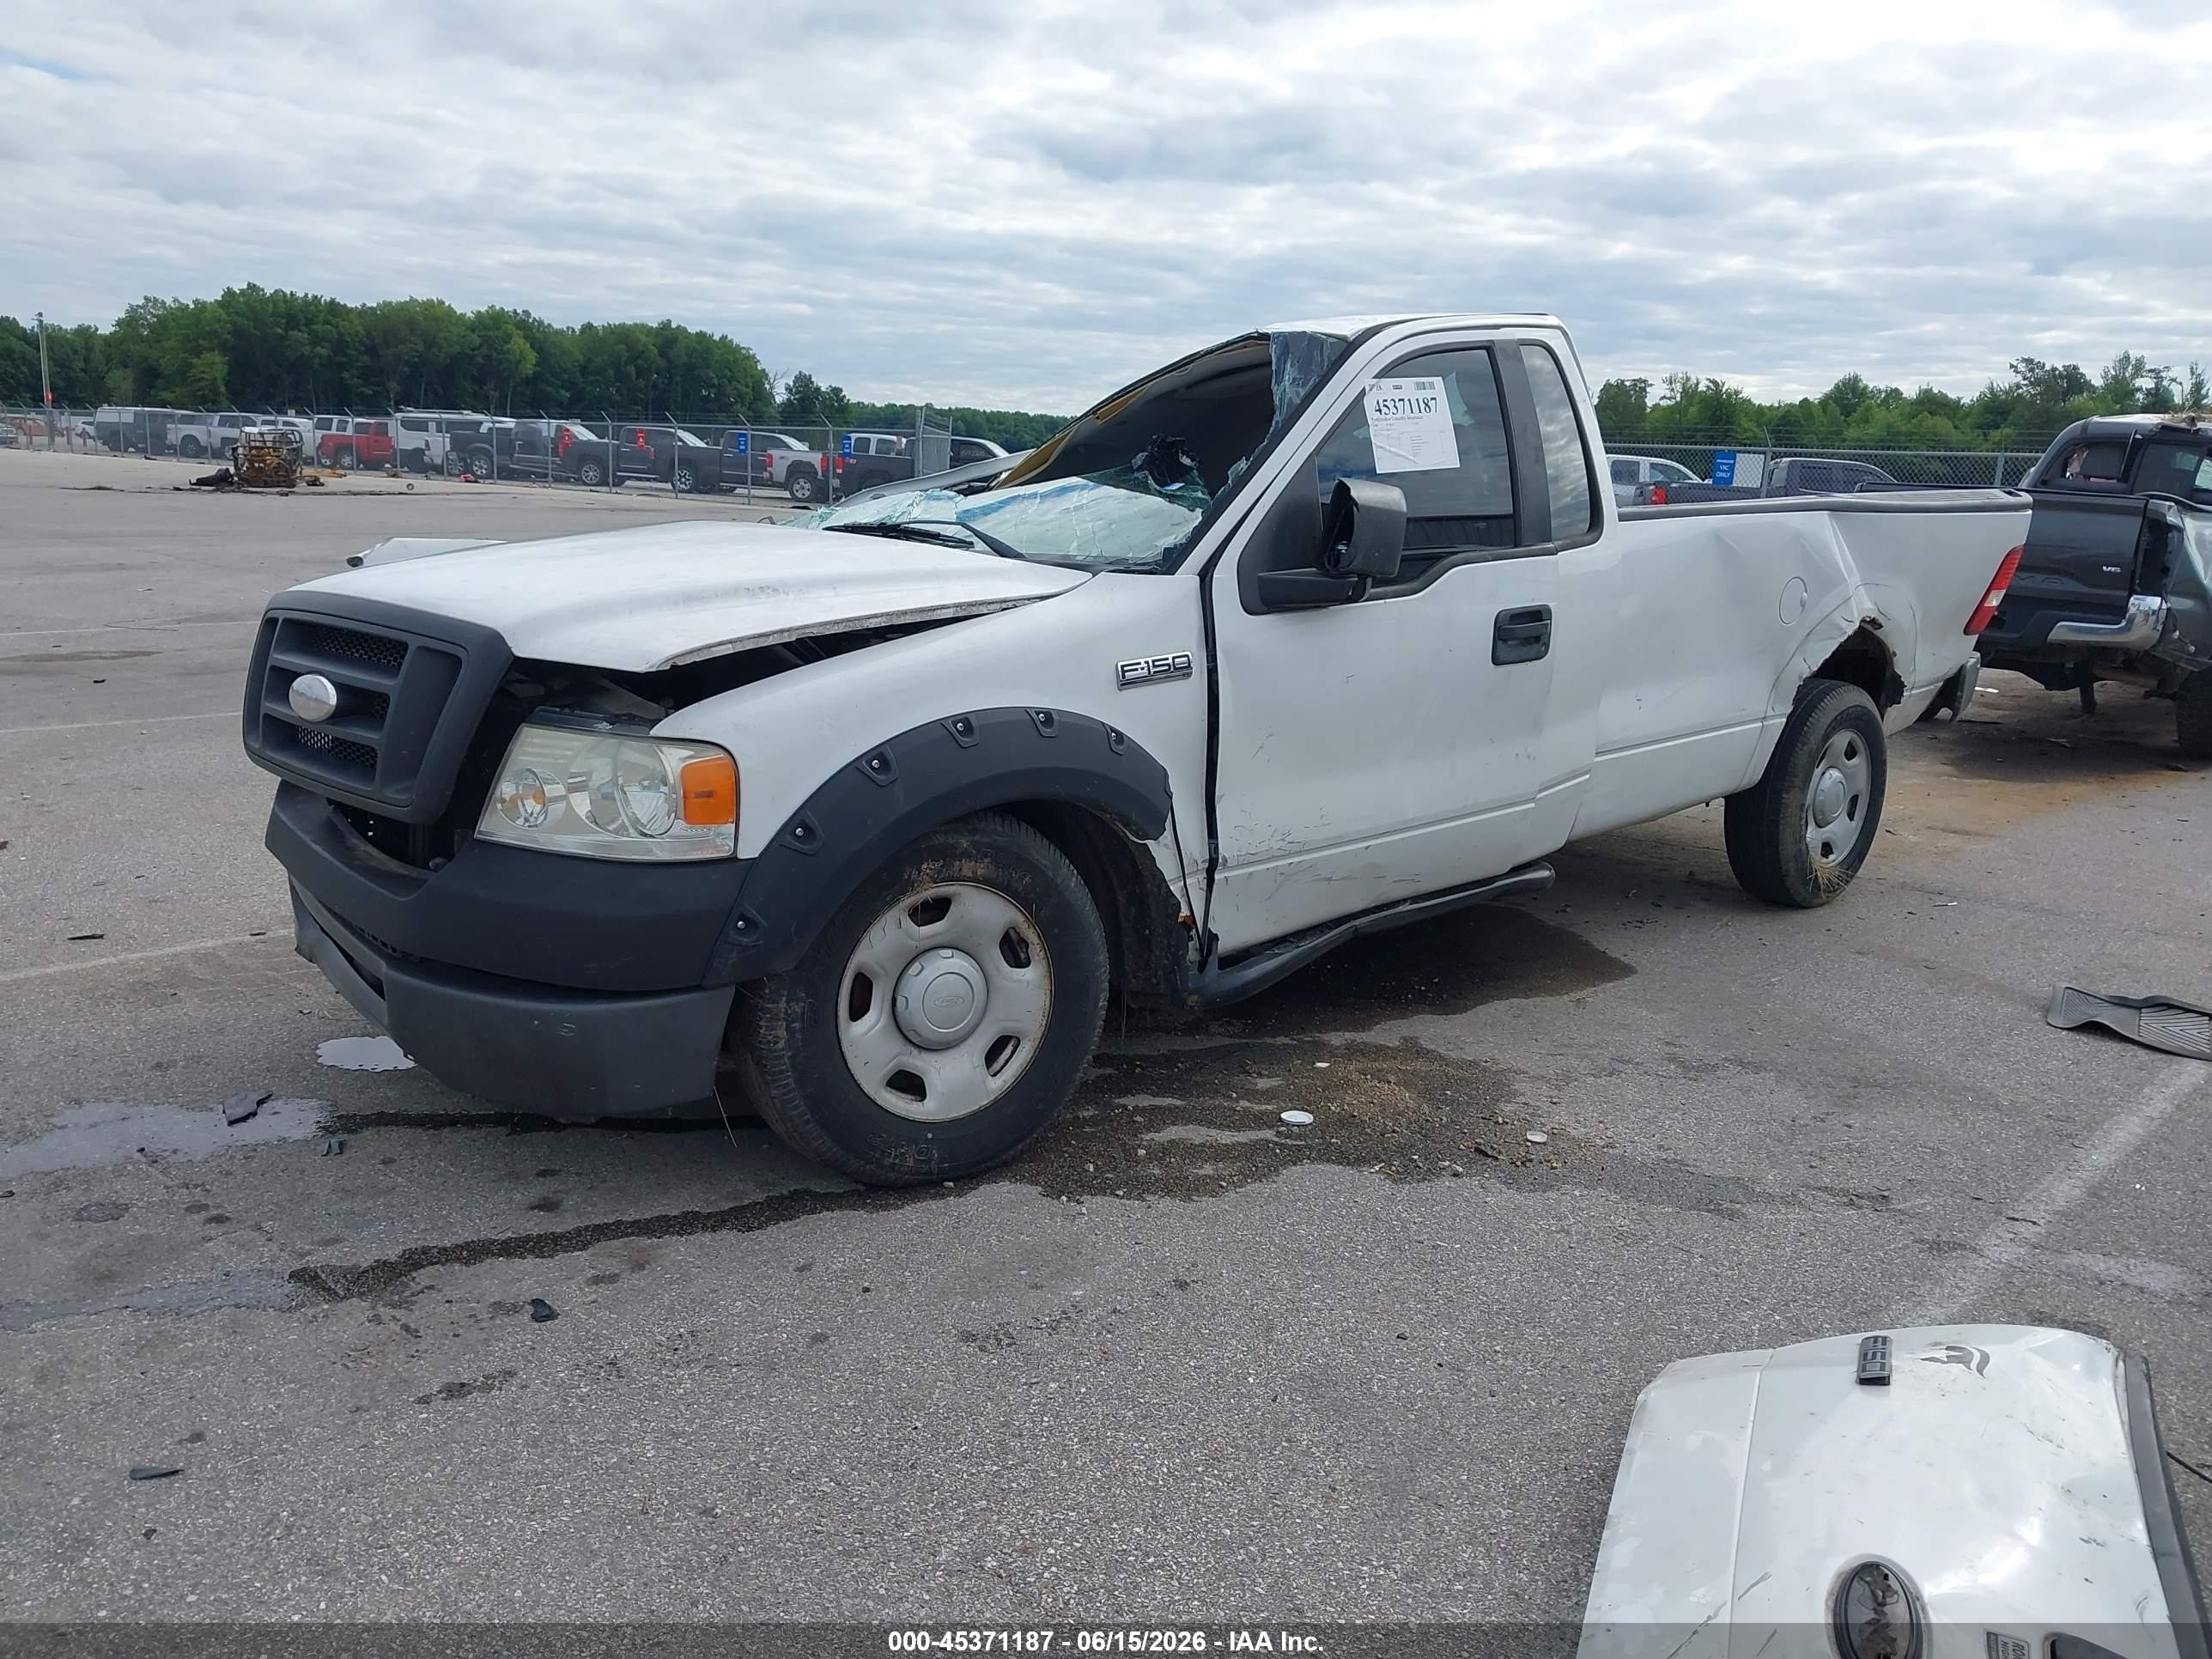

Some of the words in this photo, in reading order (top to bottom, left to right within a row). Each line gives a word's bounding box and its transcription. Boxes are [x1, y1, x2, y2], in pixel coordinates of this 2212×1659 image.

[1374, 397, 1437, 416] 45371187
[2102, 565, 2122, 574] V6
[1119, 653, 1192, 680] F-150
[1861, 1335, 1887, 1374] F-150
